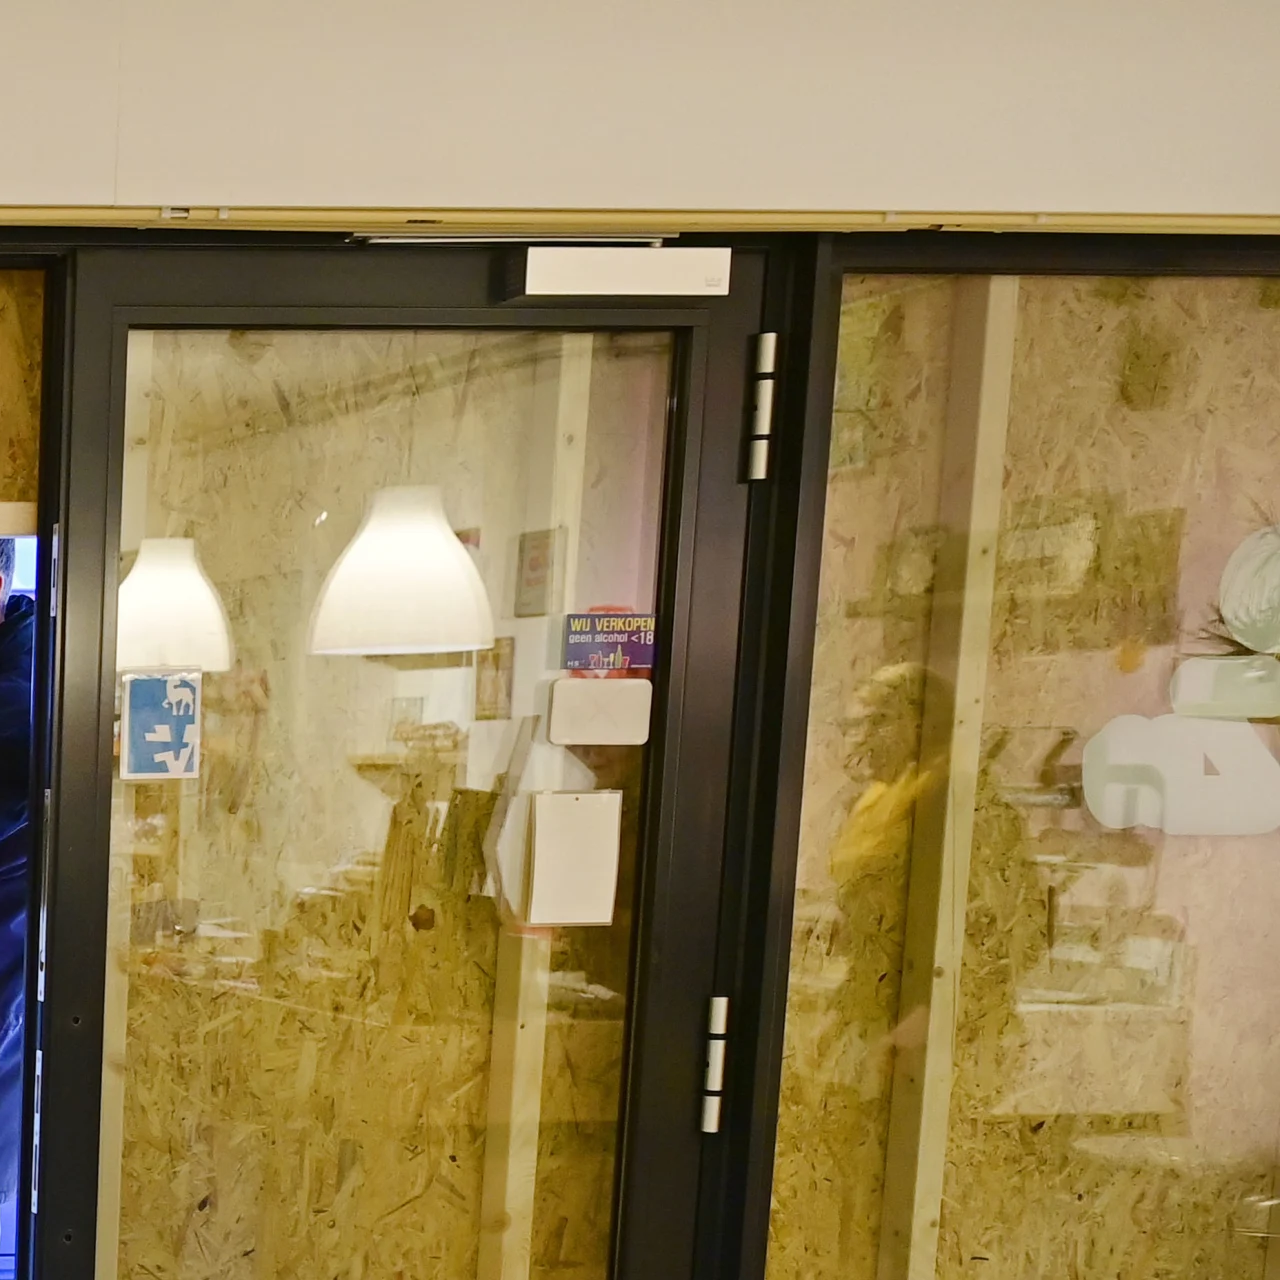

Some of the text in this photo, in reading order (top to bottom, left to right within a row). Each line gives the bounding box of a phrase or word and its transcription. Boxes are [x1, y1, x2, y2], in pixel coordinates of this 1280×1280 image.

[570, 617, 655, 632] WIJ VERKOPEN
[568, 631, 654, 645] geen alcohol <18
